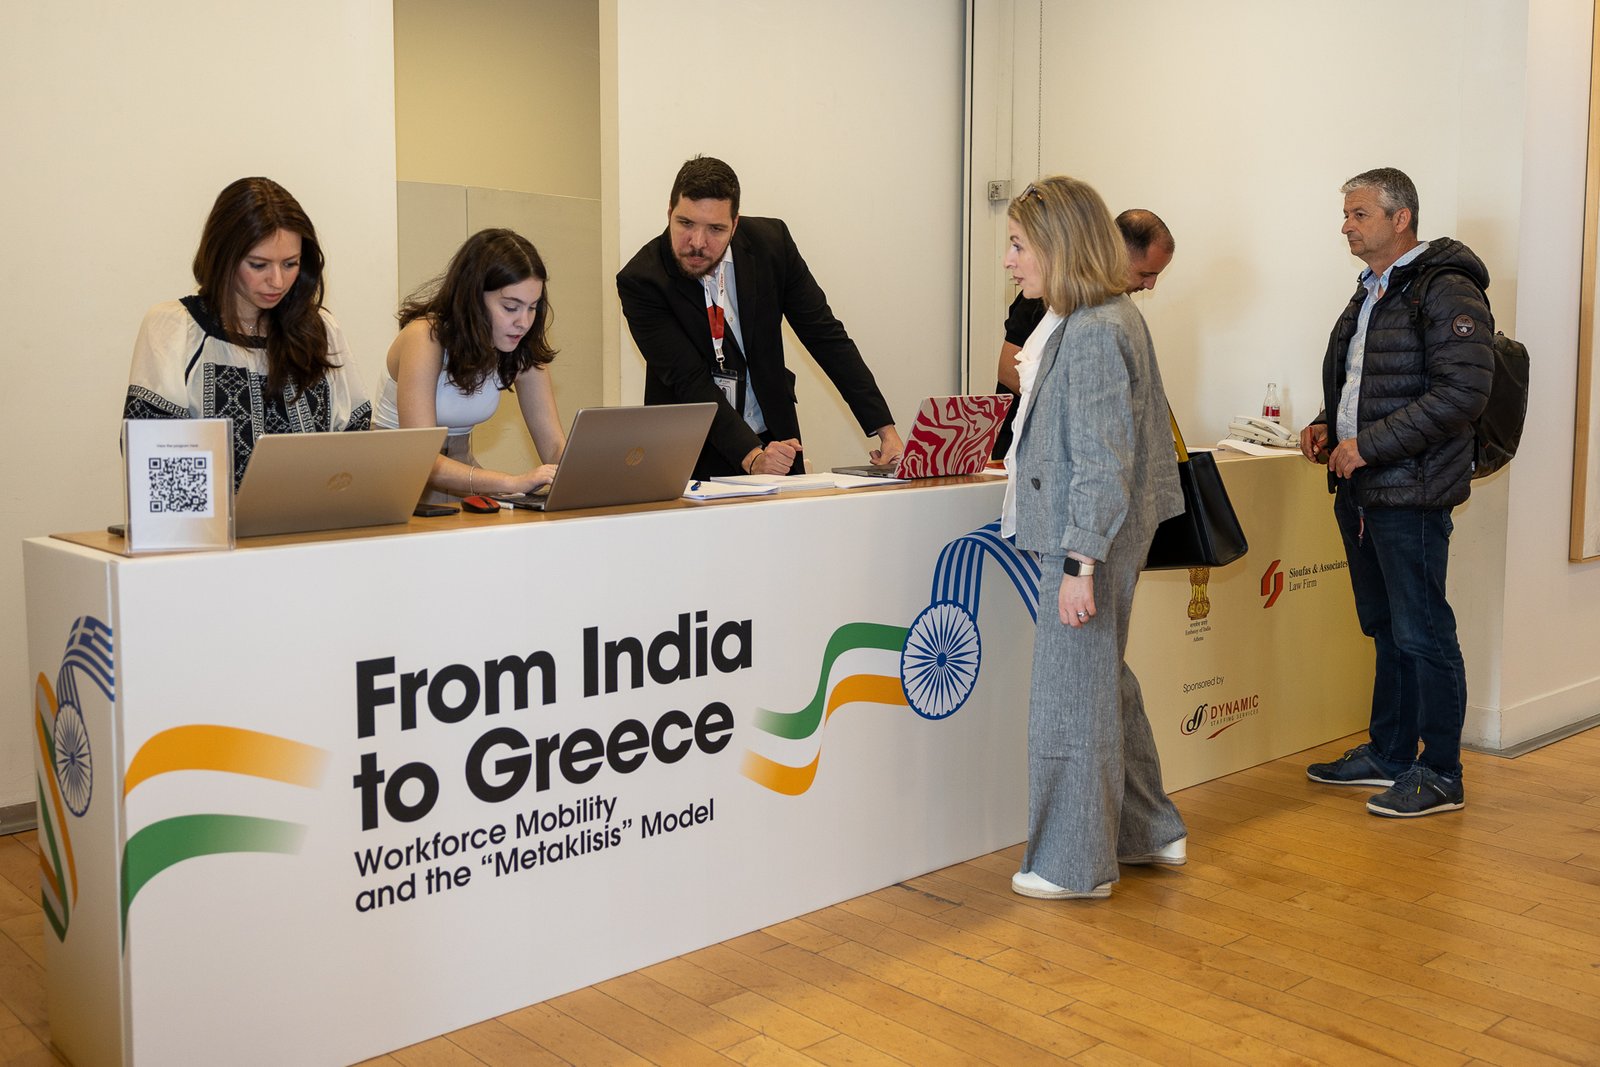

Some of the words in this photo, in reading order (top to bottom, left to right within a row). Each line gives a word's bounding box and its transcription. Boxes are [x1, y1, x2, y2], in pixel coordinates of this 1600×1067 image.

[1289, 565, 1311, 578] Sioufas
[1312, 564, 1318, 574] &
[1289, 581, 1301, 592] Law
[1302, 578, 1318, 589] Firm
[356, 649, 557, 740] From
[583, 609, 753, 698] India
[1183, 677, 1216, 694] Sponsored
[1216, 675, 1225, 686] by
[1210, 694, 1259, 720] DYNAMIC
[1210, 715, 1234, 727] STAFFING
[1236, 708, 1259, 720] SERVICES
[353, 752, 440, 832] to
[465, 701, 735, 804] Greece
[354, 820, 506, 878] Workforce
[516, 794, 618, 839] Mobility
[355, 873, 416, 913] and
[425, 865, 472, 896] the
[482, 818, 633, 877] “Metaklisis”
[641, 798, 715, 839] Model
